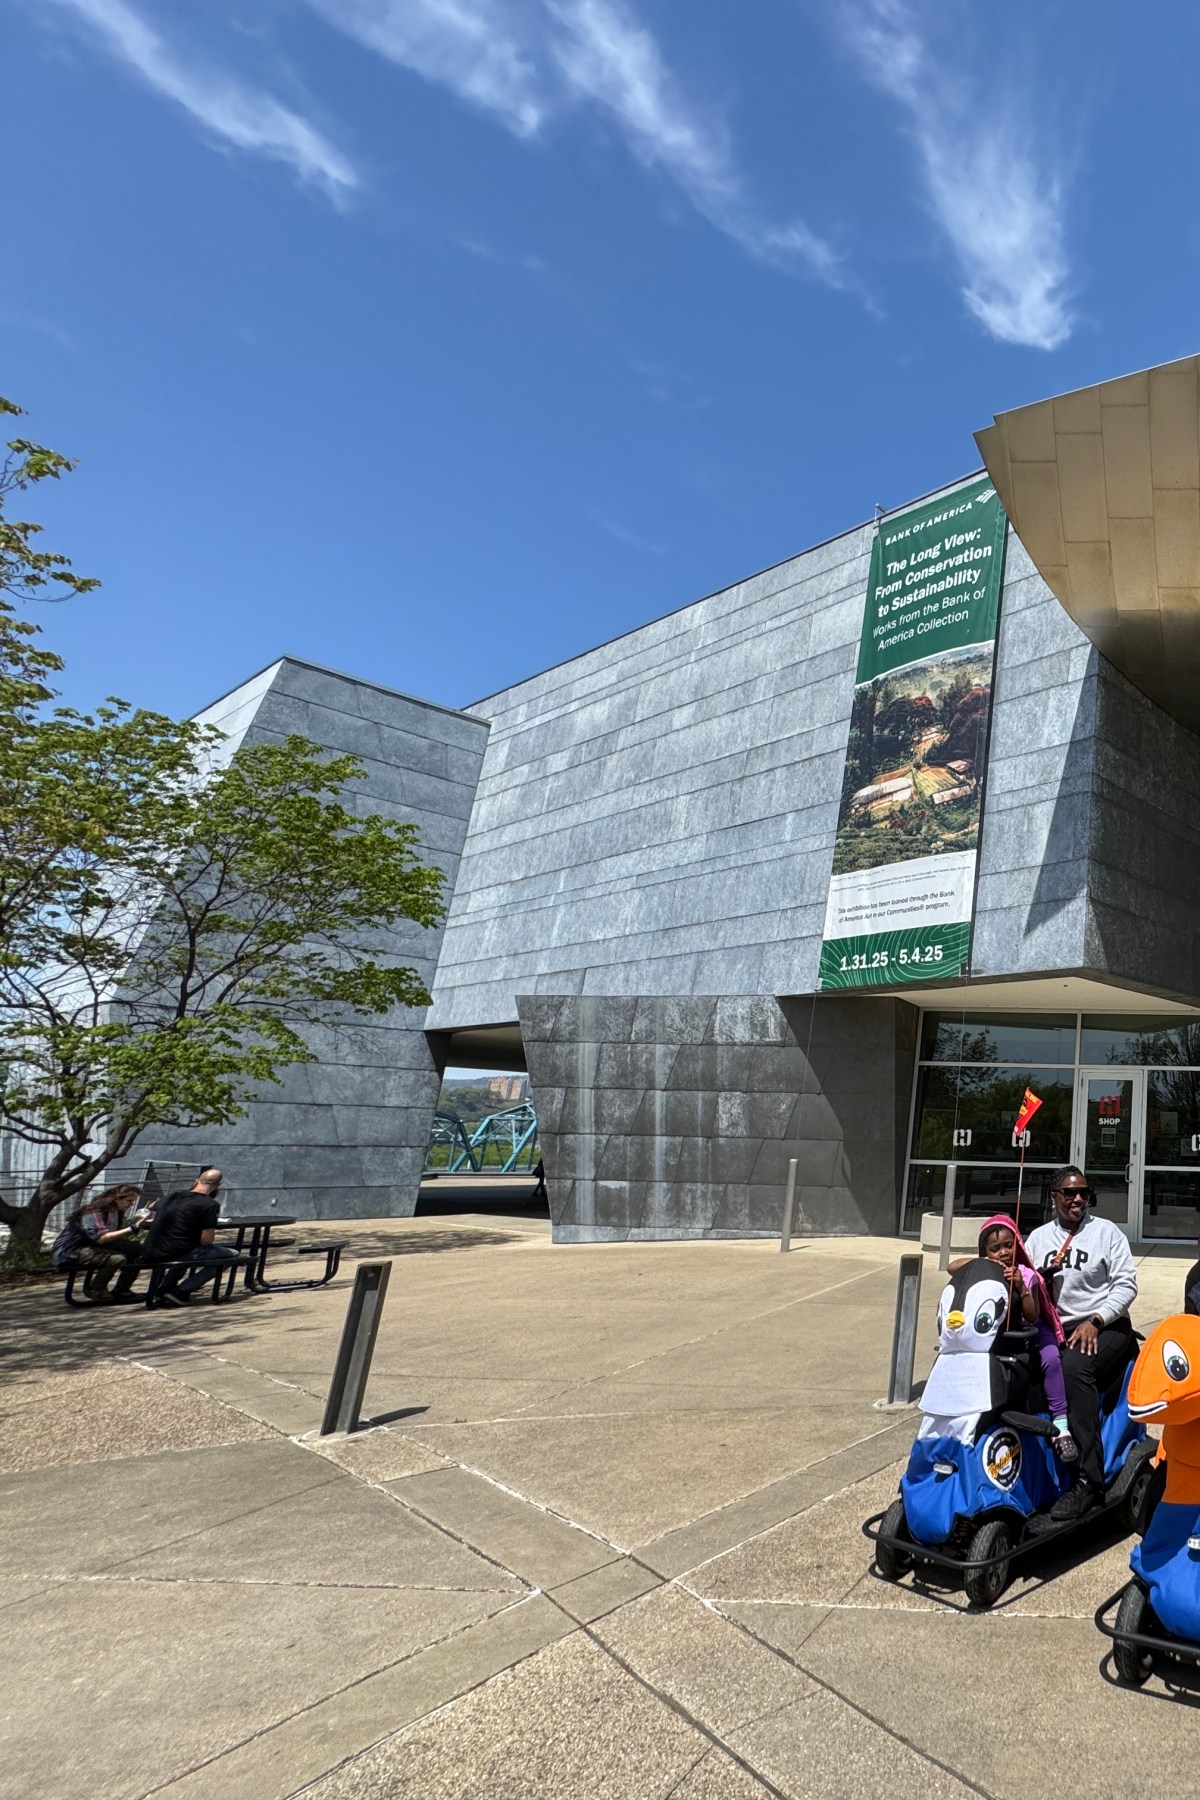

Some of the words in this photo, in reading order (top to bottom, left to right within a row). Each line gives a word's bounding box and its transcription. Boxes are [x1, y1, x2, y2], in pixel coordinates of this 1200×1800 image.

[885, 528, 911, 546] BANK
[912, 521, 926, 534] OF
[926, 502, 973, 527] AMERICA
[874, 580, 902, 601] From
[905, 545, 992, 586] Conservation
[886, 559, 907, 577] The
[910, 542, 941, 567] Long
[944, 527, 982, 550] View:
[873, 617, 897, 639] Works
[898, 609, 921, 627] from
[922, 601, 939, 616] the
[942, 590, 970, 609] Bank
[973, 586, 987, 601] of
[877, 604, 889, 618] to
[892, 568, 982, 611] Sustainability
[877, 630, 914, 652] America
[917, 609, 969, 635] Collection
[844, 914, 863, 922] America
[878, 899, 890, 908] been
[891, 897, 908, 905] loaned
[909, 893, 929, 903] through
[929, 891, 938, 899] the
[939, 889, 955, 898] Bank
[840, 951, 888, 971] 1.31.25
[899, 945, 943, 964] 5.4.25
[1098, 1117, 1121, 1126] SHOP
